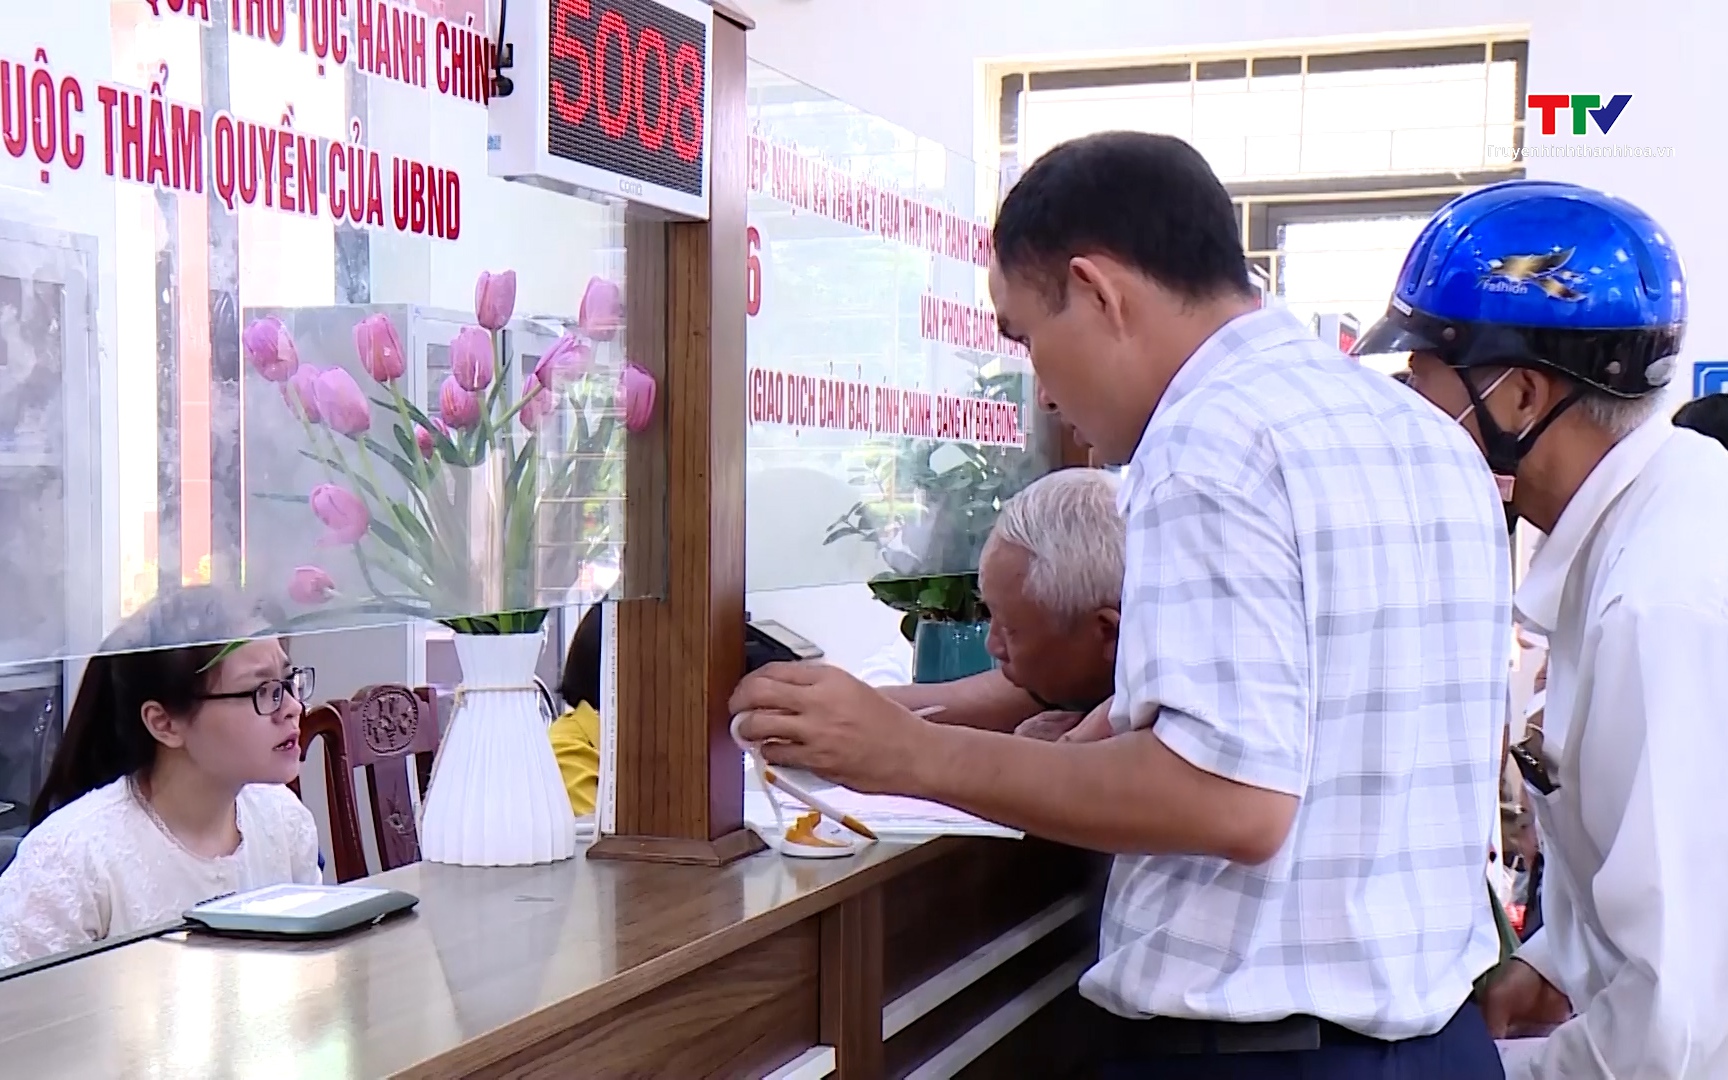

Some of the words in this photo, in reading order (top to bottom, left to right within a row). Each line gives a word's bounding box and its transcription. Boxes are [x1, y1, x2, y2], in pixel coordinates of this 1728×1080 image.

[97, 62, 202, 194] THẨM
[215, 101, 318, 211] QUYỀN
[328, 121, 384, 227] CỦA
[393, 156, 461, 241] UBND
[552, 0, 702, 164] 5008
[748, 367, 784, 427] (GIAO
[787, 373, 816, 437] DỊCH
[819, 361, 845, 429] ĐẢM
[848, 363, 874, 440] BẢO,
[936, 387, 961, 440] ĐĂNG
